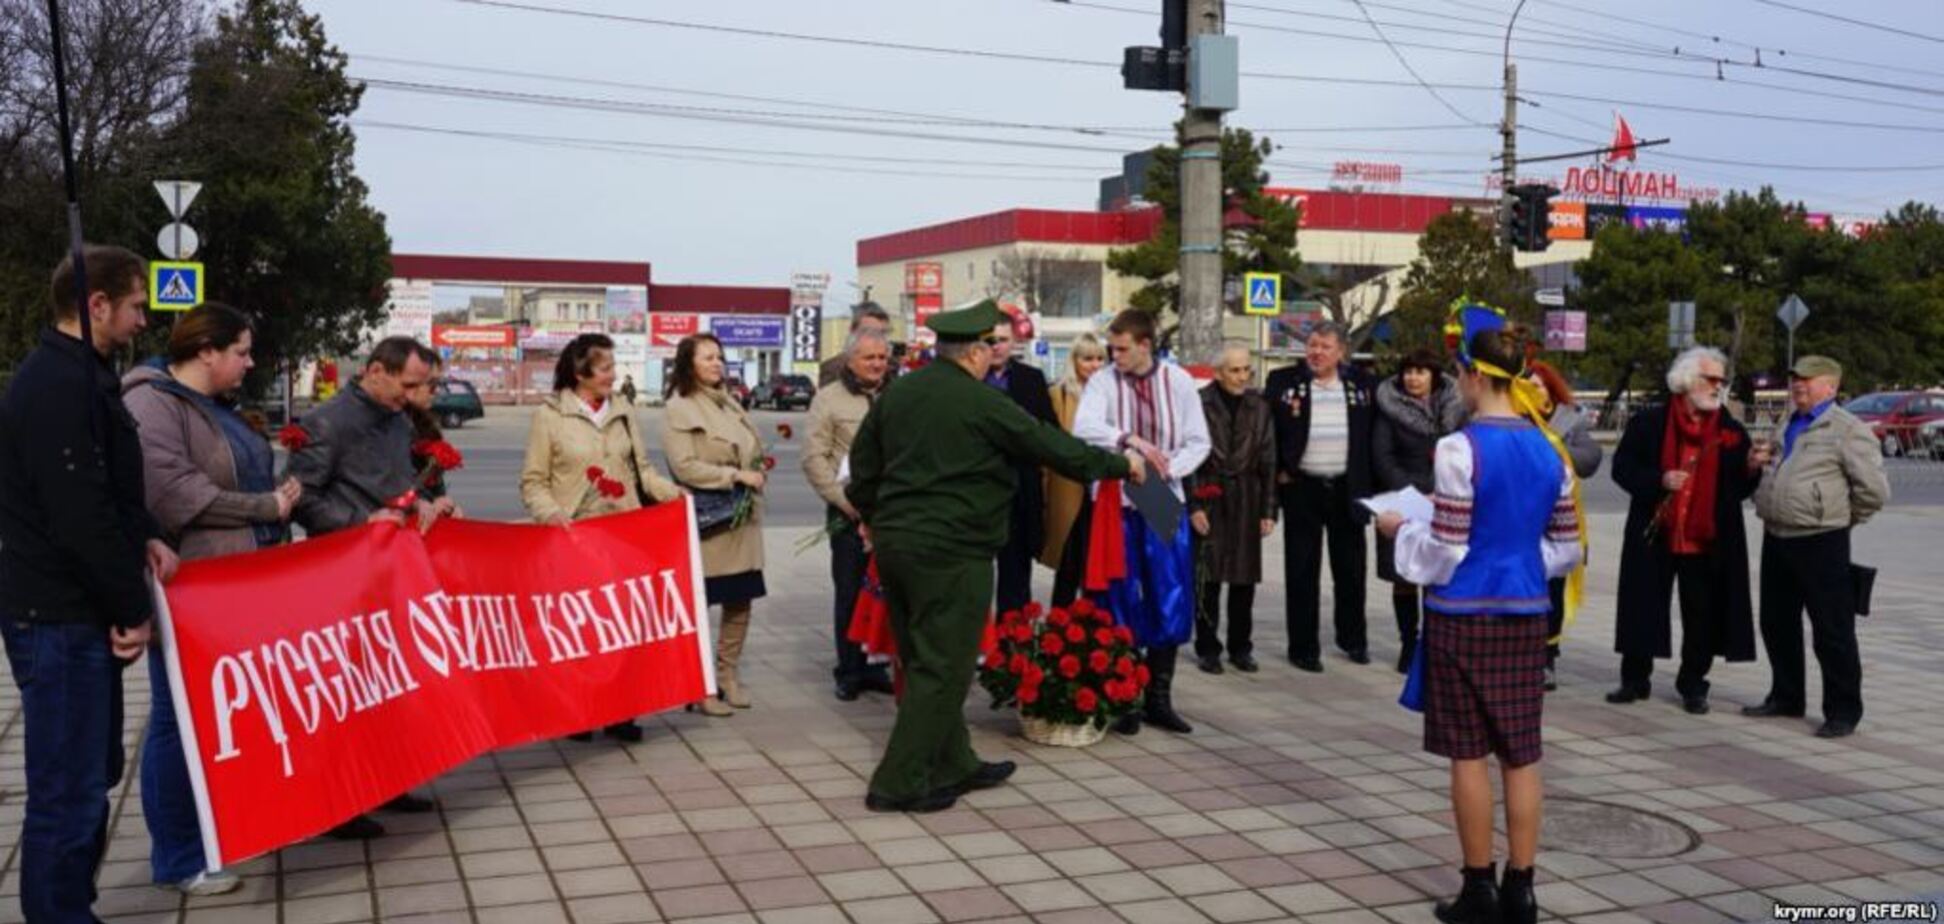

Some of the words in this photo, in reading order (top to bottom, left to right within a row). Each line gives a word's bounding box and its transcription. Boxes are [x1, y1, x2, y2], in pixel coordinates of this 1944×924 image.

[1563, 166, 1677, 198] ЛОЦМАН
[796, 307, 816, 359] ОБОИ
[211, 609, 420, 778] РУССКАЯ
[531, 569, 697, 663] КРЫМА
